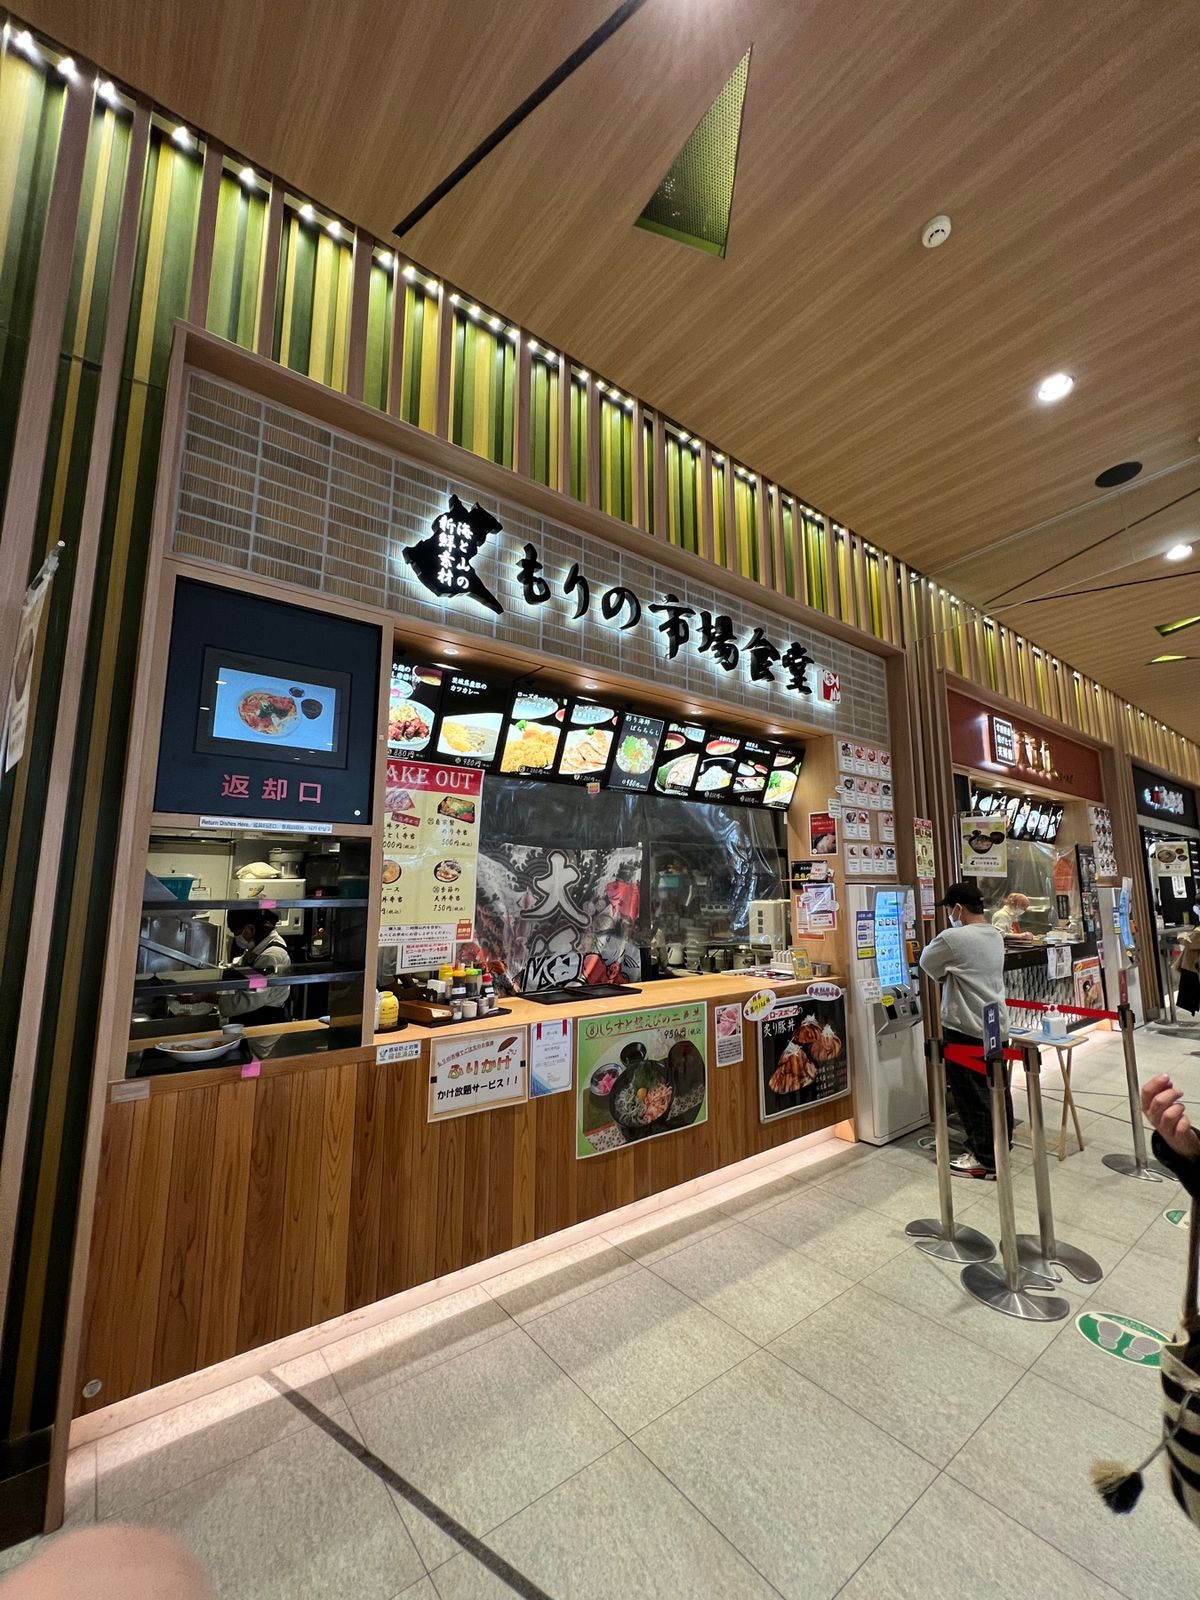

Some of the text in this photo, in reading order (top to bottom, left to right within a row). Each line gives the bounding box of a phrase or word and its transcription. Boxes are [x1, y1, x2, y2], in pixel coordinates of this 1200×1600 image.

[437, 514, 457, 588] 新鮮素材
[456, 521, 474, 590] 海と山の
[515, 542, 815, 697] もりの市場食堂
[450, 684, 481, 696] カツカレー
[220, 773, 322, 804] 返却口
[386, 764, 475, 790] AKE OUT
[201, 819, 219, 827] Return
[763, 1018, 796, 1038] 炙り豚丼
[448, 1055, 512, 1080] ふりかけ
